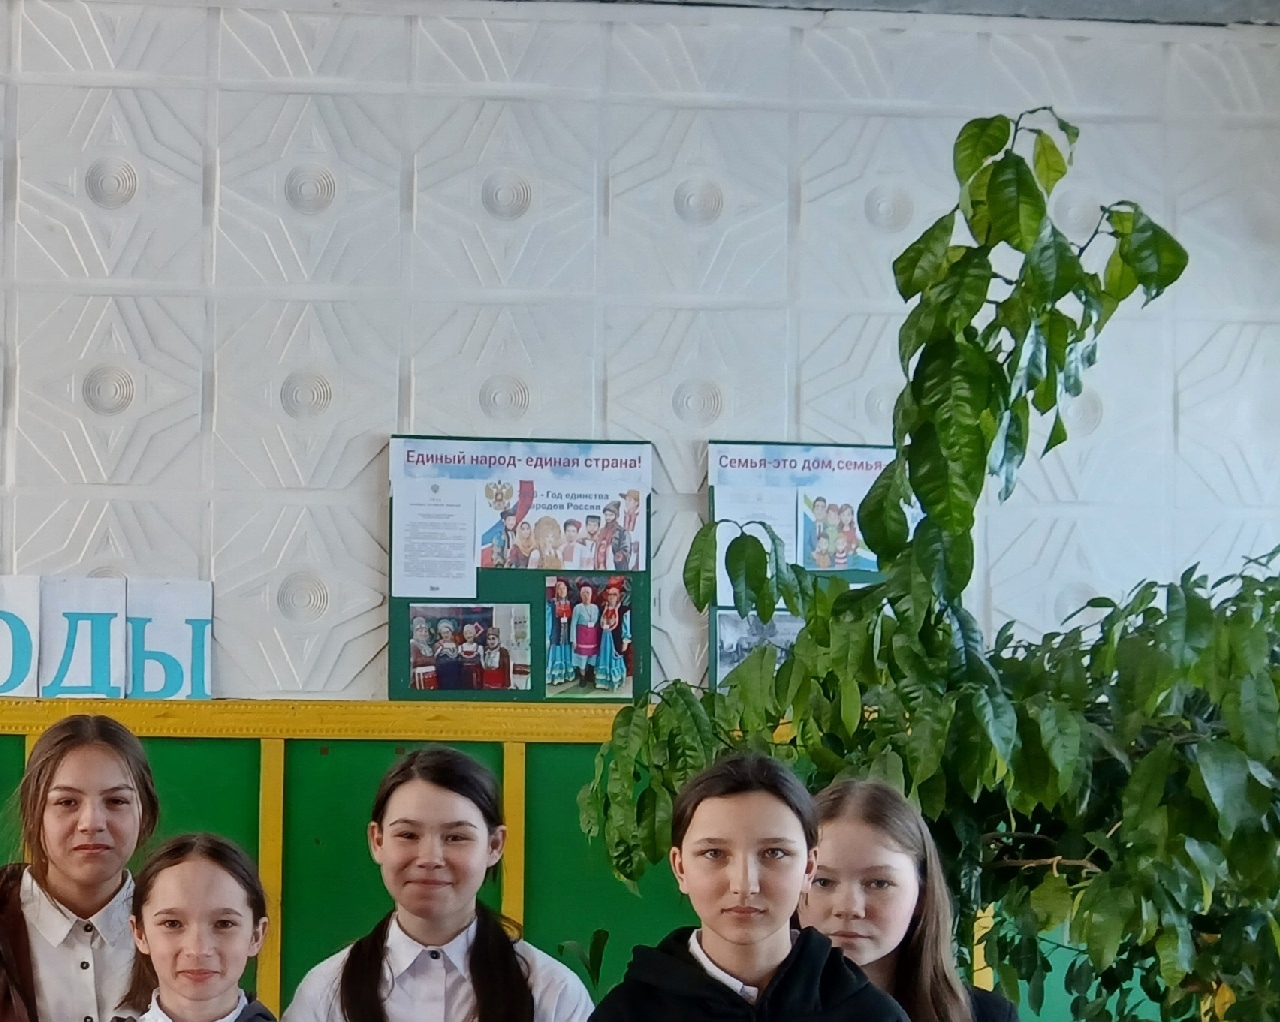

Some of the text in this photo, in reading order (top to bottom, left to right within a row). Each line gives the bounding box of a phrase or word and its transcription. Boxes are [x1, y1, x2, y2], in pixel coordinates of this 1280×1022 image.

[406, 450, 466, 466] Единый
[525, 455, 580, 469] единая
[584, 456, 643, 471] страна!
[546, 491, 563, 500] Год
[567, 502, 601, 511] России
